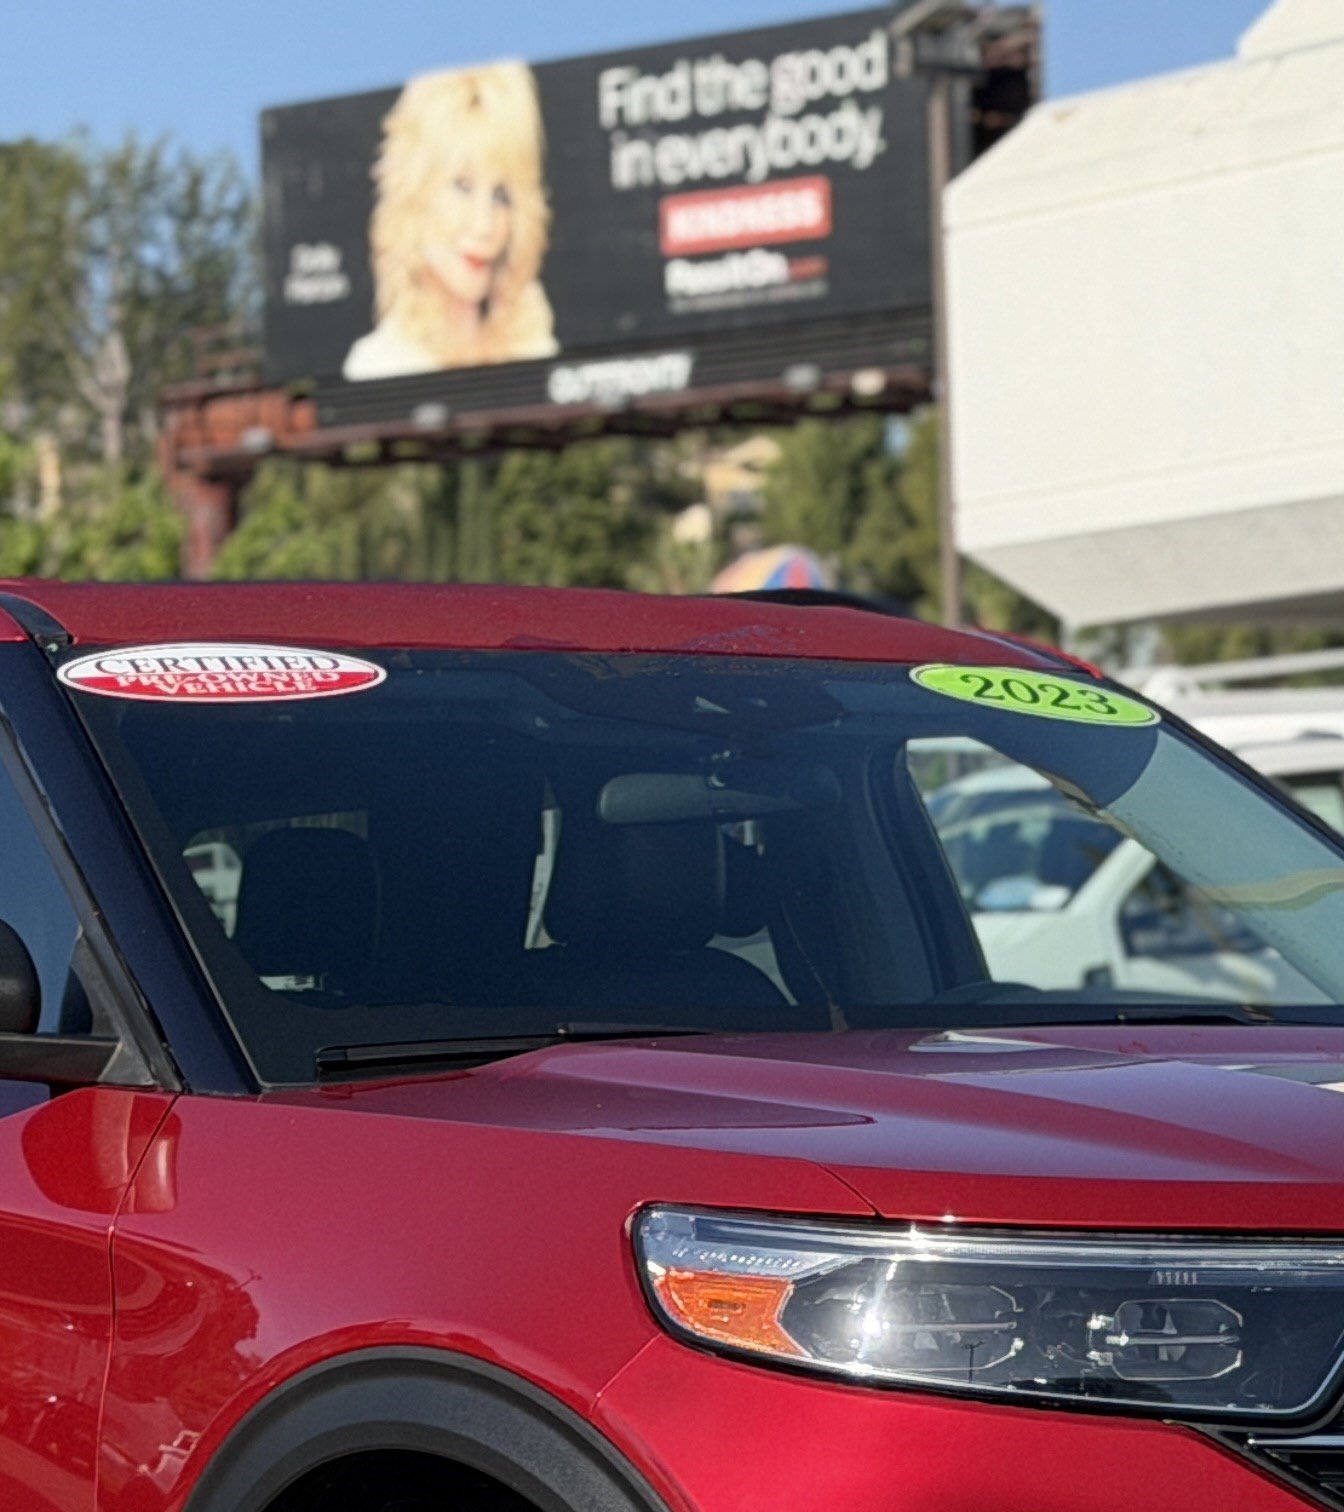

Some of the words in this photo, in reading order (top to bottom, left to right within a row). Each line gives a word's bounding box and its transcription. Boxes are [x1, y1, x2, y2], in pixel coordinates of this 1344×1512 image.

[598, 58, 691, 130] Find
[693, 54, 768, 117] the
[769, 29, 888, 117] good
[609, 130, 655, 190] in
[95, 655, 340, 674] CERTIFIED
[158, 677, 317, 695] VEHICLE
[959, 673, 1118, 715] 2023
